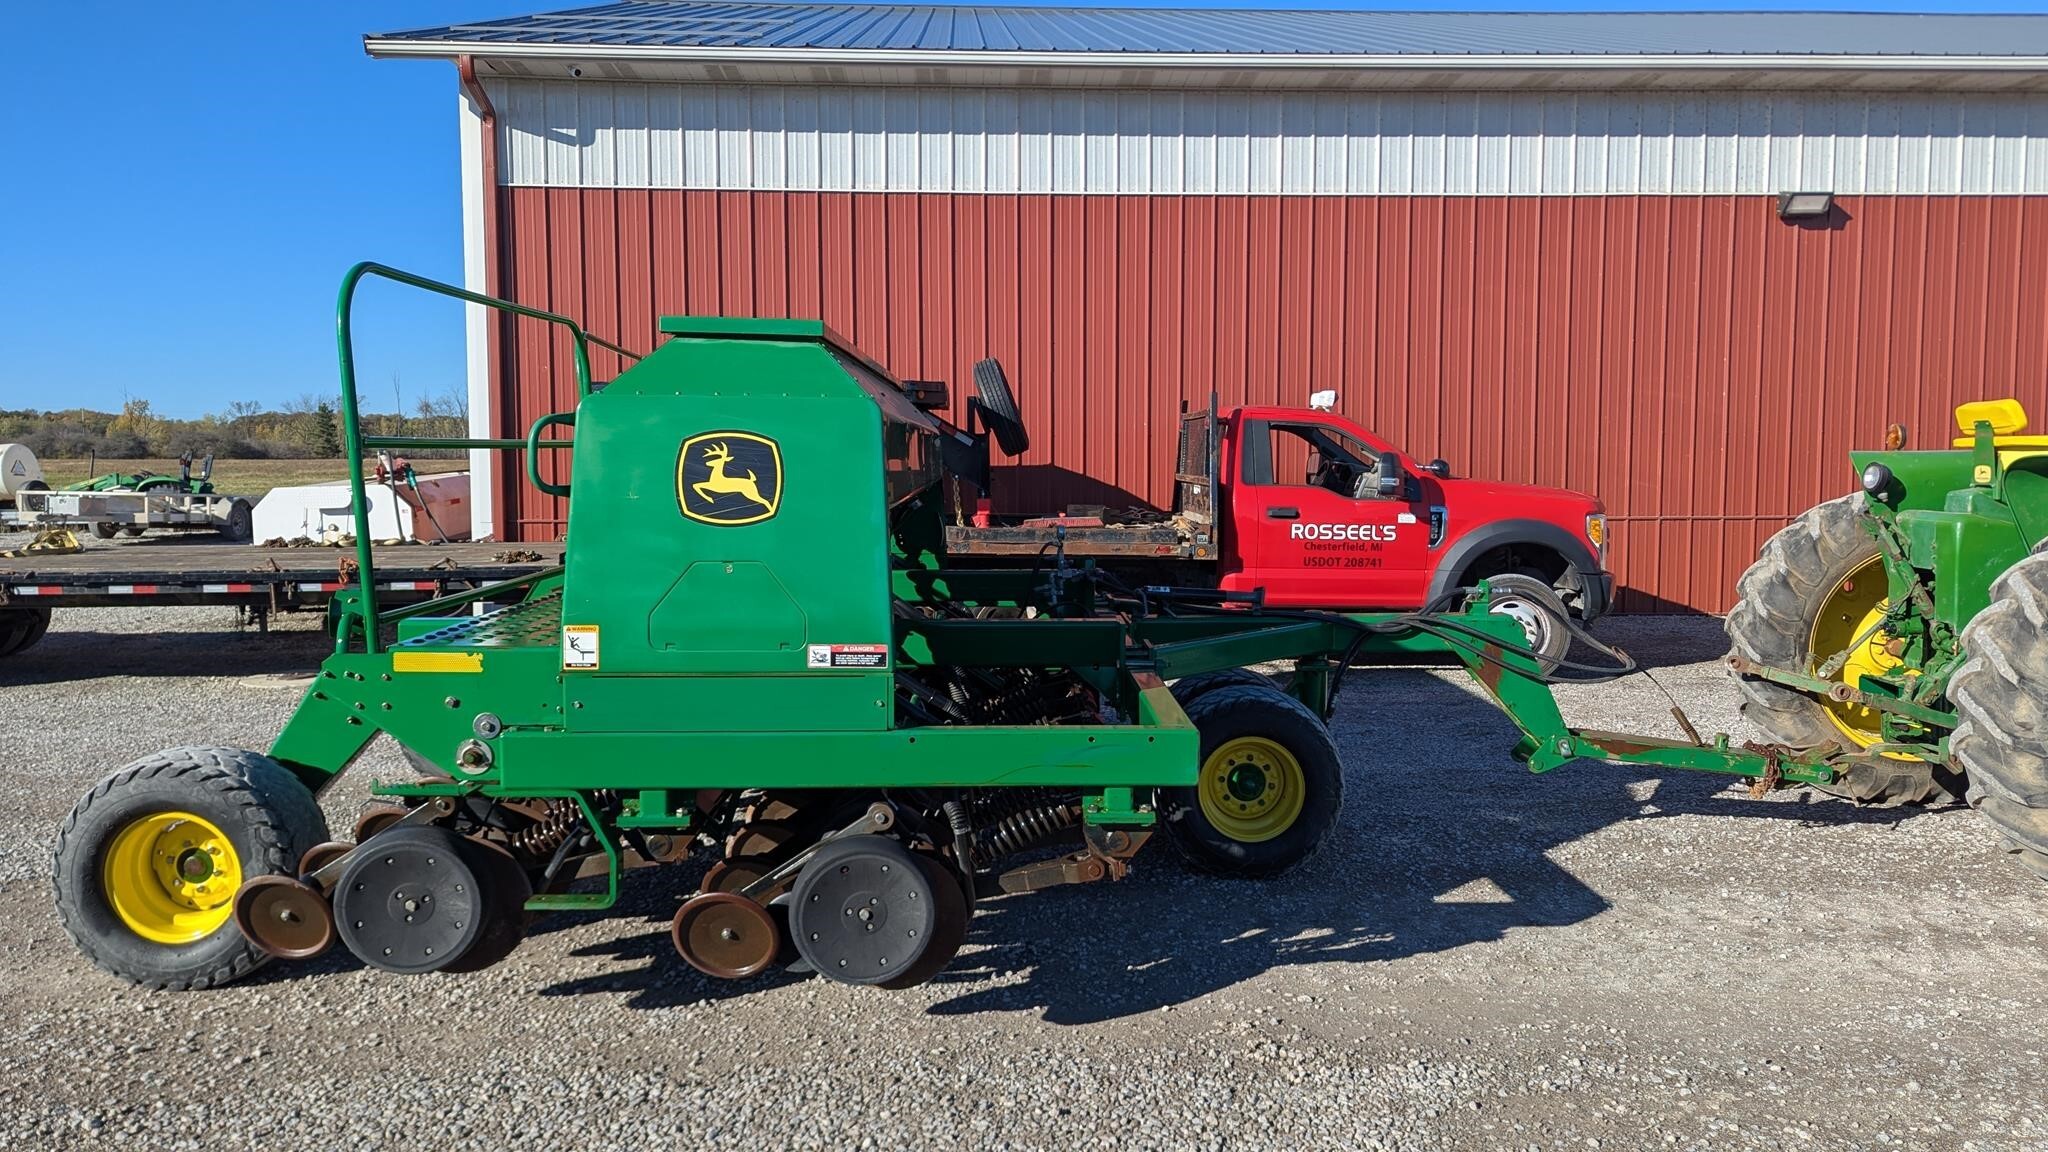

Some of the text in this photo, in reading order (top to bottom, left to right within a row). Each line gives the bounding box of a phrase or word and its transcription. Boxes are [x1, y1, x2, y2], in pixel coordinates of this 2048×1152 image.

[1291, 523, 1397, 541] ROSSEEL'S
[1304, 541, 1368, 552] Chesterfield,
[1303, 556, 1382, 568] USDOT 208741
